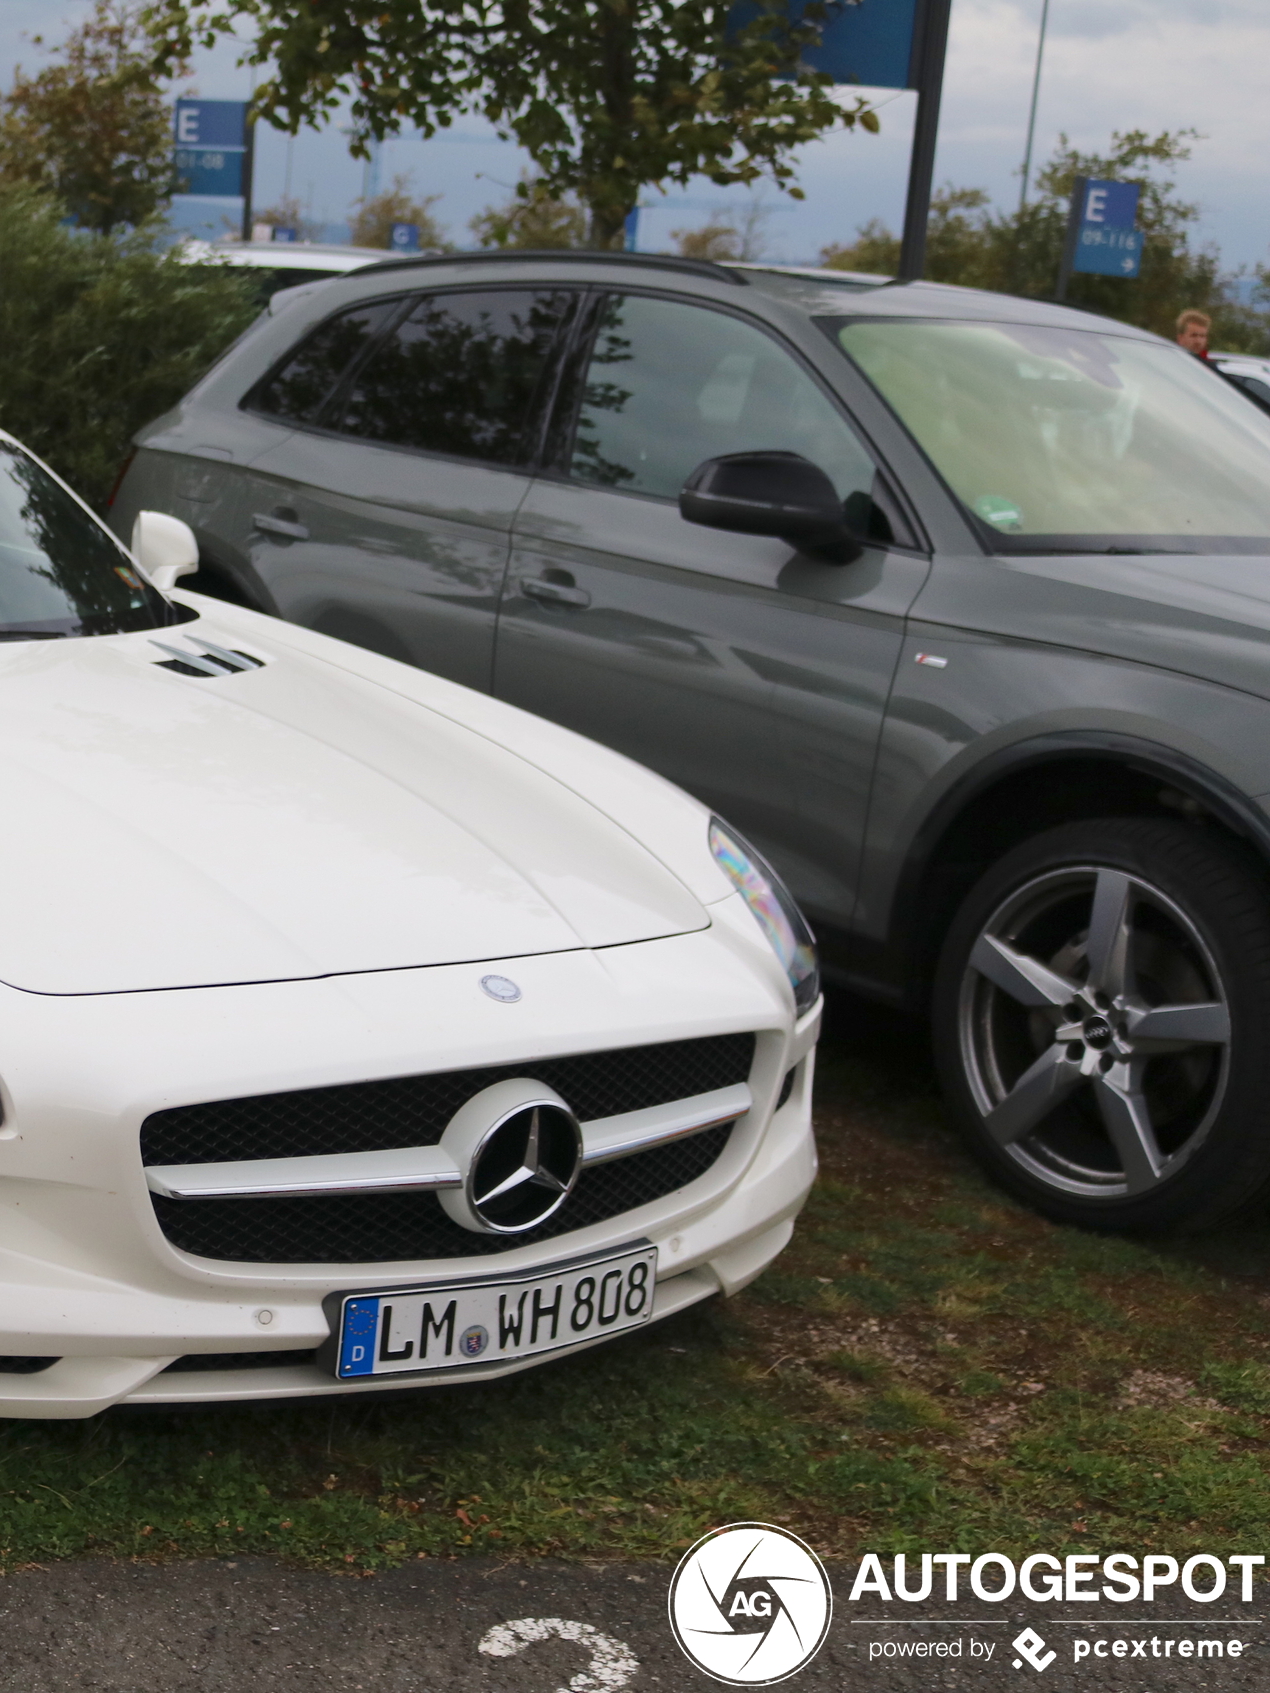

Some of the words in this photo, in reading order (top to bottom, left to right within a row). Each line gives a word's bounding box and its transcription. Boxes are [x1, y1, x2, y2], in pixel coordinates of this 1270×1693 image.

[178, 108, 200, 142] E
[1085, 188, 1107, 222] E
[379, 1300, 457, 1361] LM
[351, 1346, 365, 1362] D
